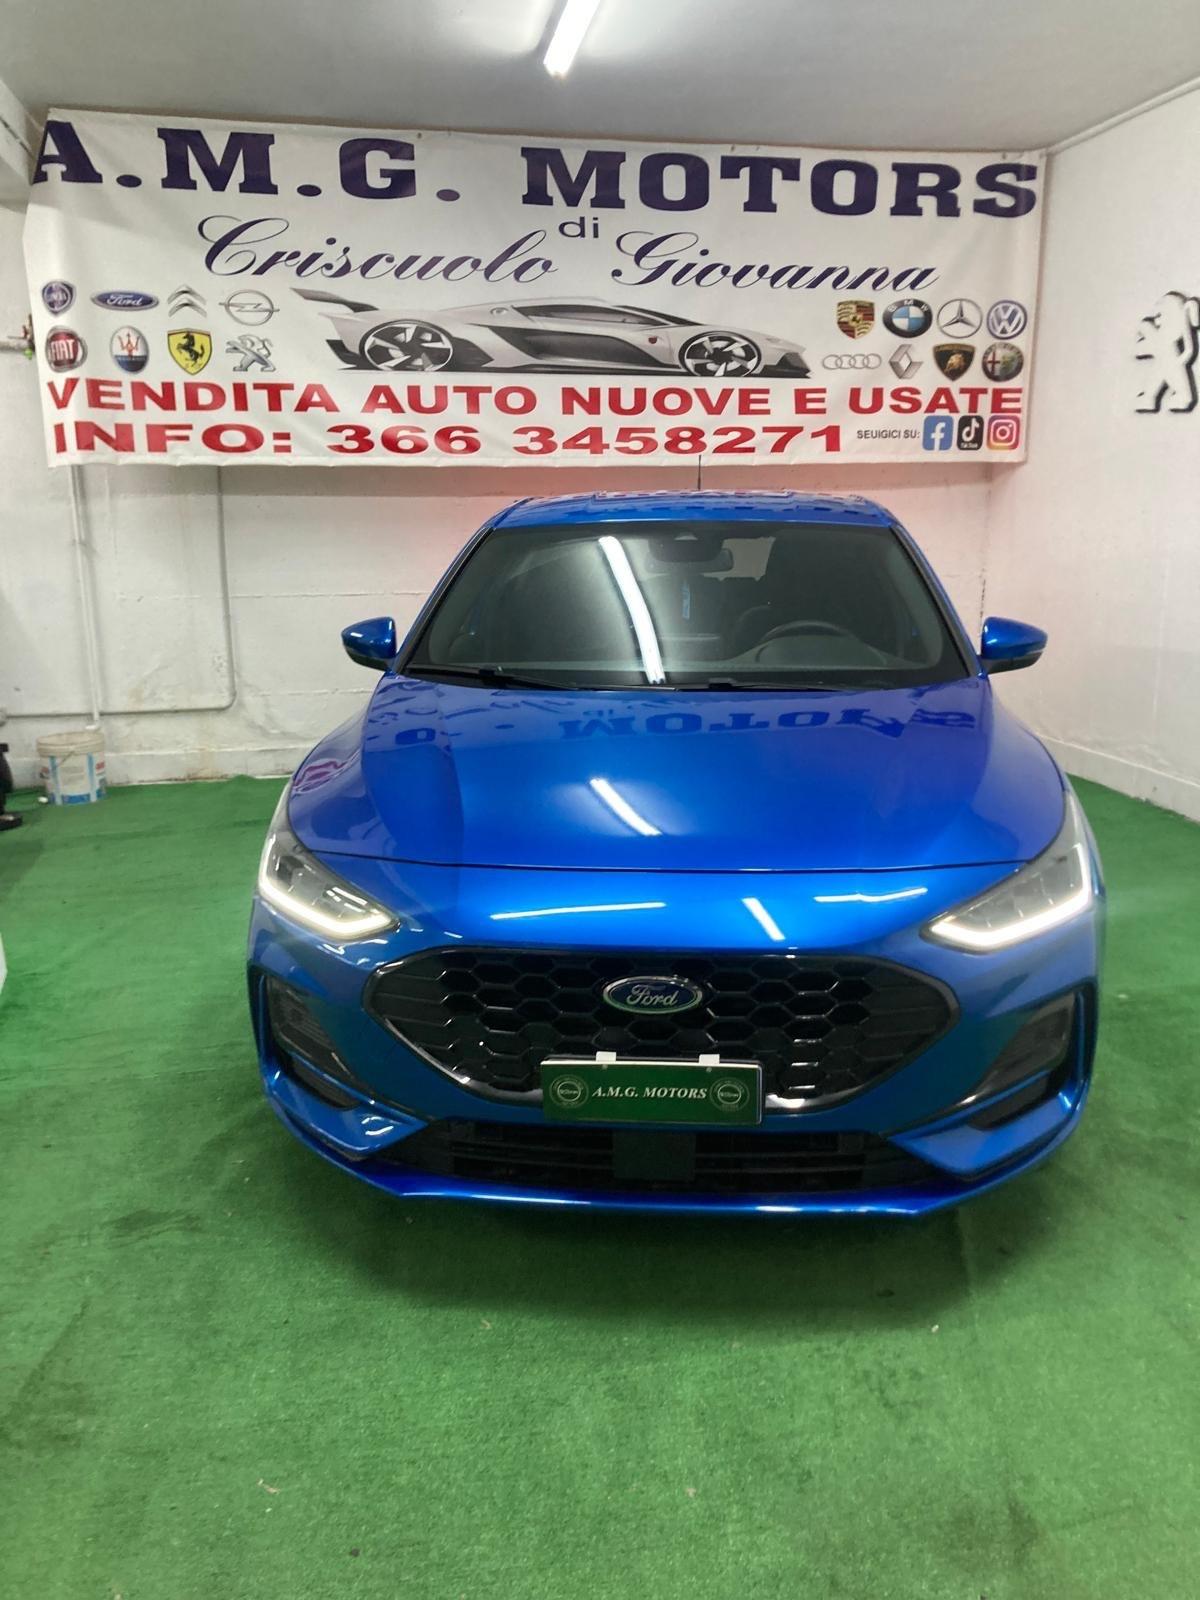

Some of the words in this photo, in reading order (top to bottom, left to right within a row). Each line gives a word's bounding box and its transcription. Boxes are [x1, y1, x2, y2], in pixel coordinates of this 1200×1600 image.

[33, 120, 461, 202] A.M.G.
[520, 147, 1037, 218] MOTORS
[558, 216, 599, 238] di
[197, 215, 559, 283] Criscuolo
[611, 231, 940, 291] Giovanna
[106, 294, 143, 306] Ford
[47, 377, 340, 413] VENDITA
[361, 384, 537, 415] AUTO
[561, 386, 770, 416] NUOVE
[794, 387, 827, 415] E
[849, 386, 1023, 415] USATE
[53, 421, 291, 454] INFO:
[326, 424, 481, 455] 366
[512, 425, 841, 455] 3458271
[903, 429, 920, 439] SU:
[626, 984, 680, 1006] Ford
[592, 1086, 639, 1098] A.M.G.
[642, 1086, 708, 1099] MOTORS
